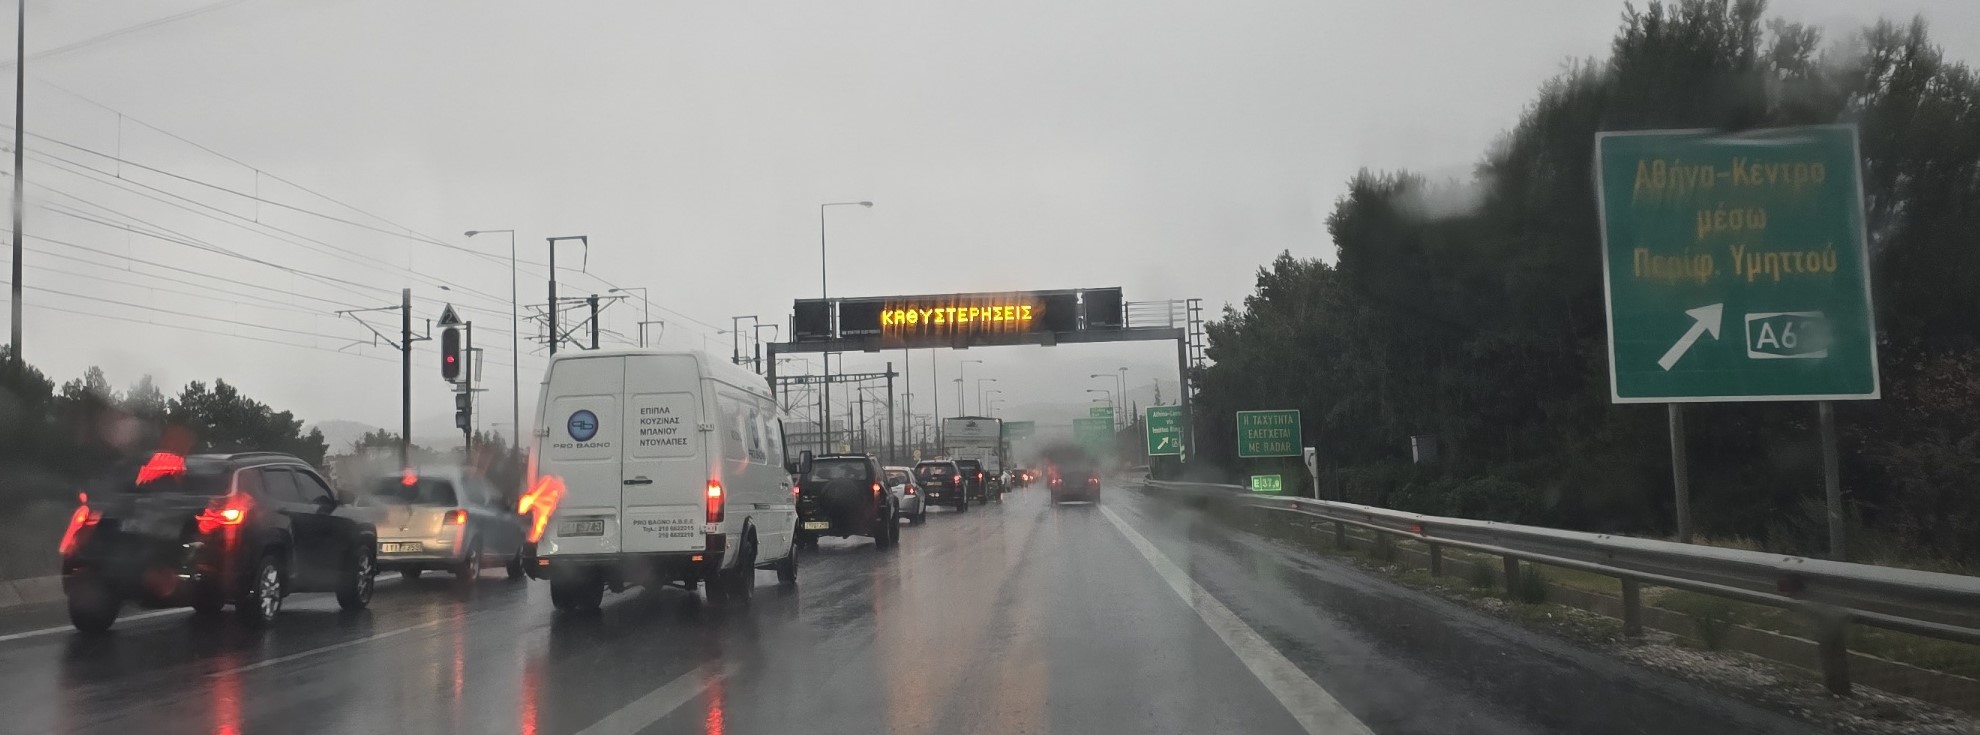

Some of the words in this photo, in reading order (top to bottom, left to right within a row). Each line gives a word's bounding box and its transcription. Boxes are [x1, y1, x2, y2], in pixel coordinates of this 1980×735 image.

[1697, 202, 1767, 238] μέσω
[1730, 242, 1838, 282] Υμηττού
[882, 305, 1032, 325] ΚΑΘΥΣΤΕΡΗΣΕΙΣ
[640, 407, 670, 415] ΕΠΙΠΛΑ
[640, 417, 680, 425] ΚΟΥΖΙΝΑΣ
[1253, 414, 1293, 425] ΤΑΧΥΤΗΤΑ
[640, 428, 677, 436] ΜΠΑΝΙΟΥ
[1248, 428, 1291, 439] ΕΛΕΓΧΕΤΑΙ
[640, 438, 688, 446] ΝΤΟΥΛΑΠΕΣ
[1248, 442, 1260, 453] ΜΕ
[1264, 441, 1291, 452] RADAR
